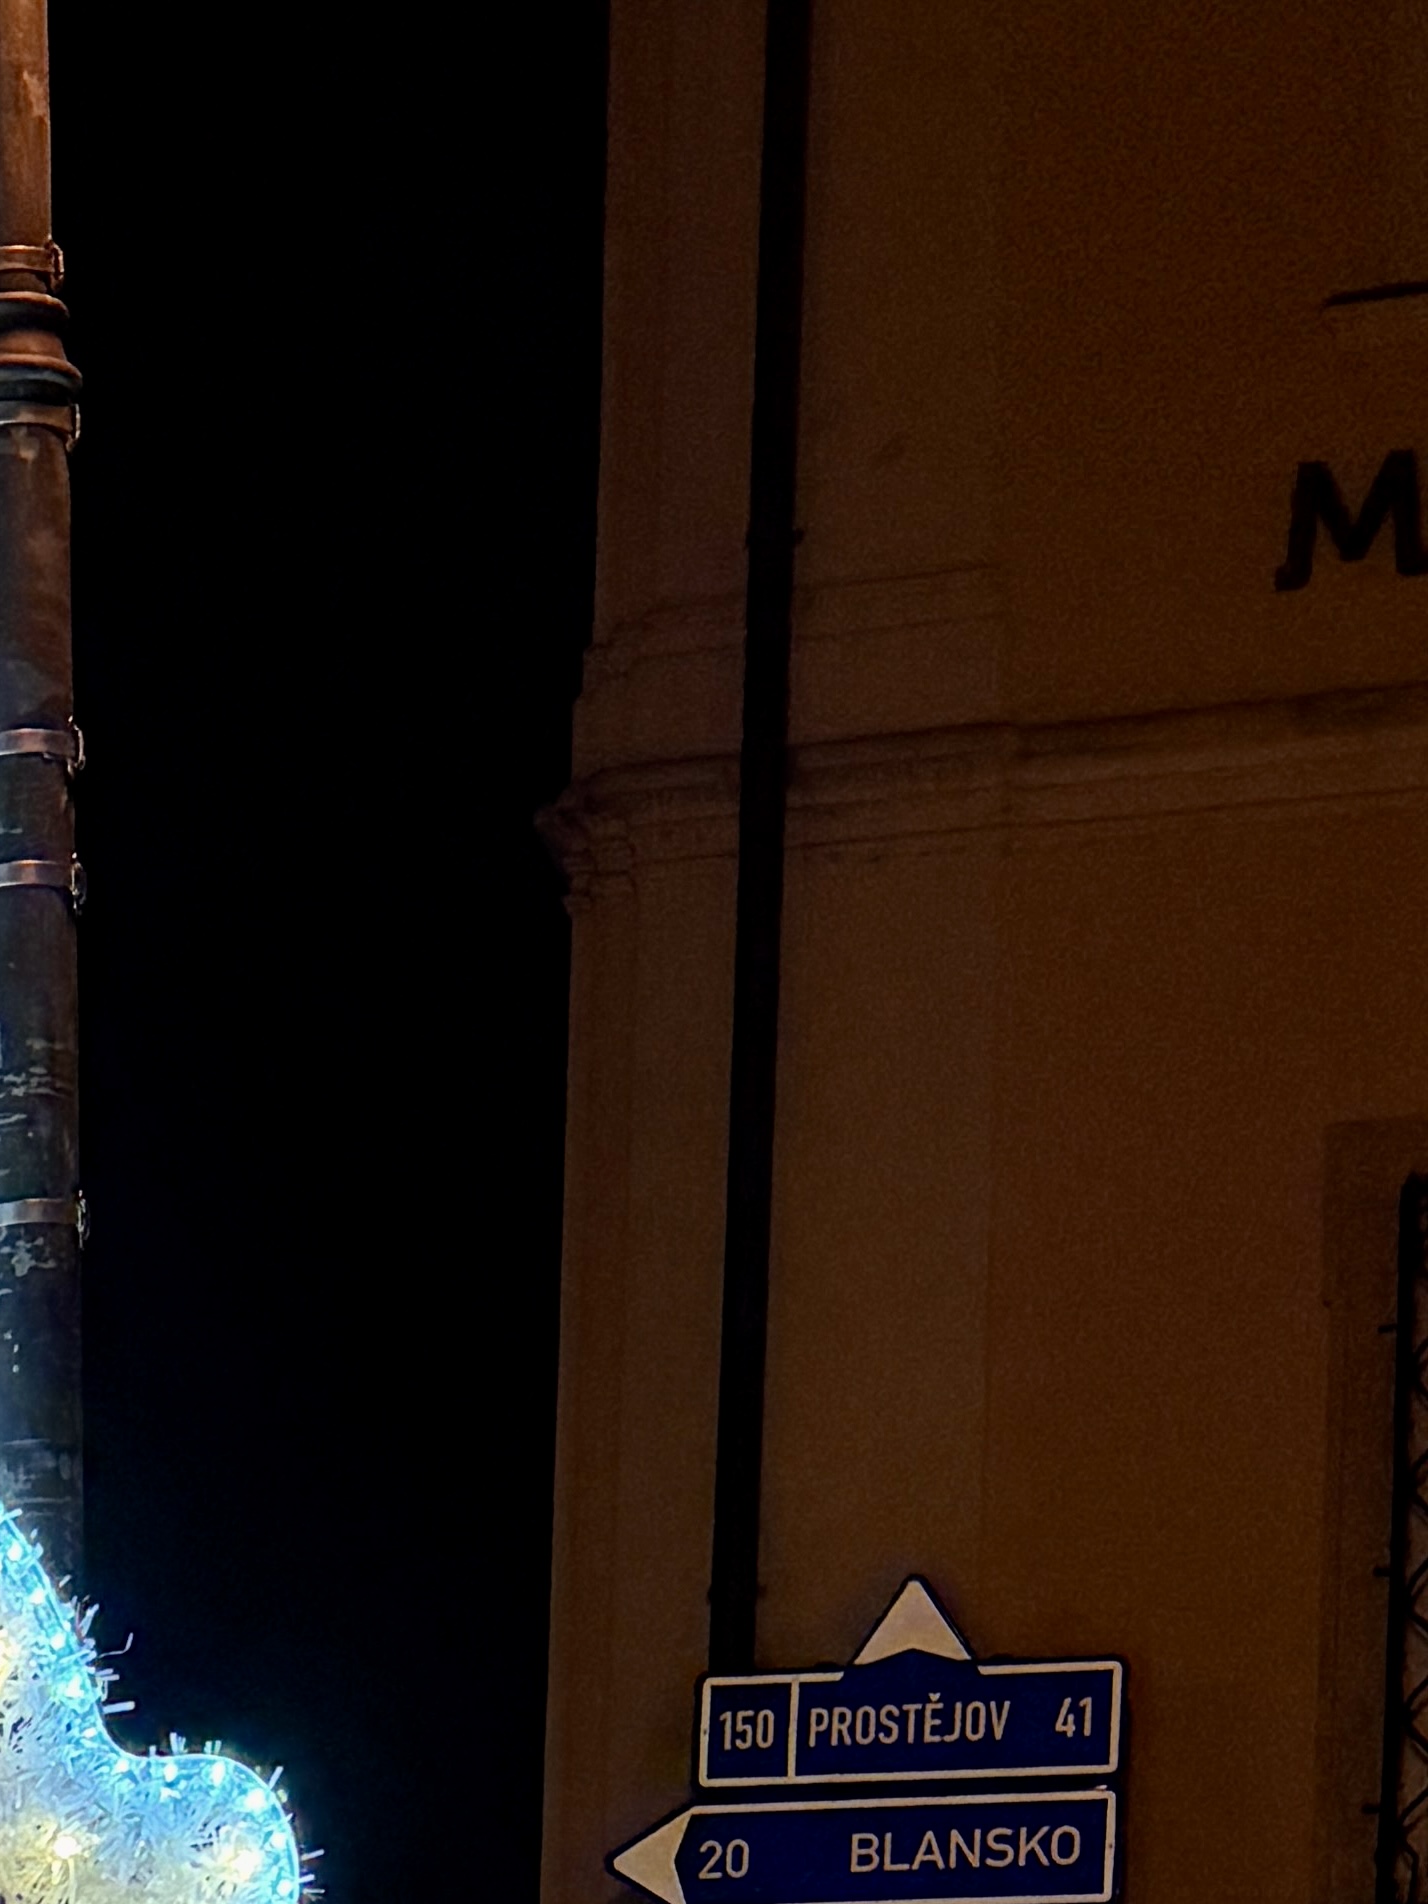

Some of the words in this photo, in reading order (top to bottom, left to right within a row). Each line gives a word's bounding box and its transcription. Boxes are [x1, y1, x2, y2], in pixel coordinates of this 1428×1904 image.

[718, 1709, 775, 1750] 150
[808, 1691, 1011, 1748] PROSTĚJOV
[1054, 1696, 1094, 1738] 41
[697, 1838, 750, 1880] 20
[849, 1824, 1082, 1874] BLANSKO
